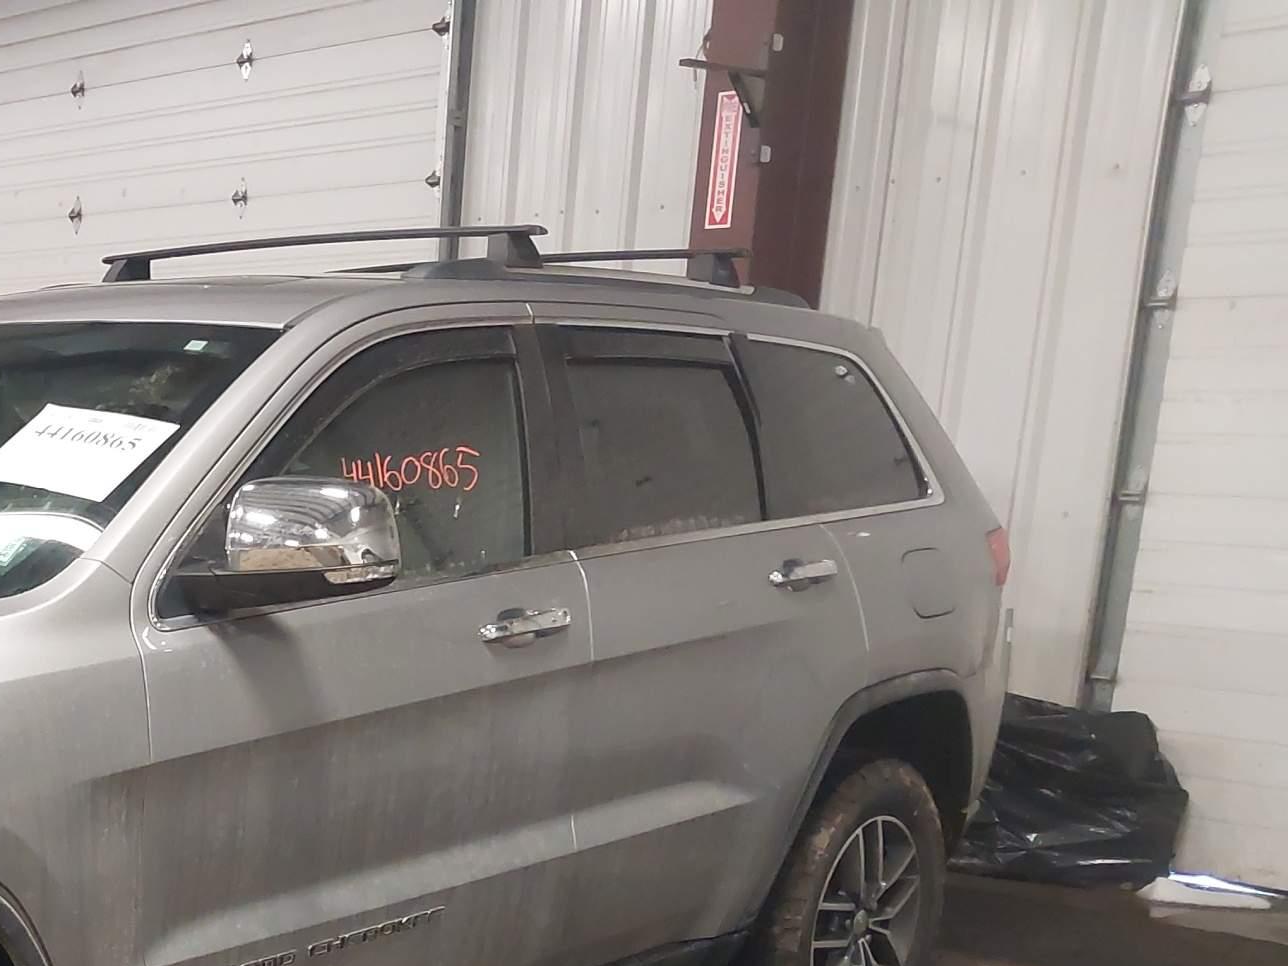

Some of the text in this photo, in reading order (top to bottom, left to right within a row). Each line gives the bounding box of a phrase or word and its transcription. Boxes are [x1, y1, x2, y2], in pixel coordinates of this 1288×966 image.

[715, 114, 732, 213] EXTINGUISHER
[35, 424, 143, 451] 44160865
[341, 446, 481, 491] 44160865
